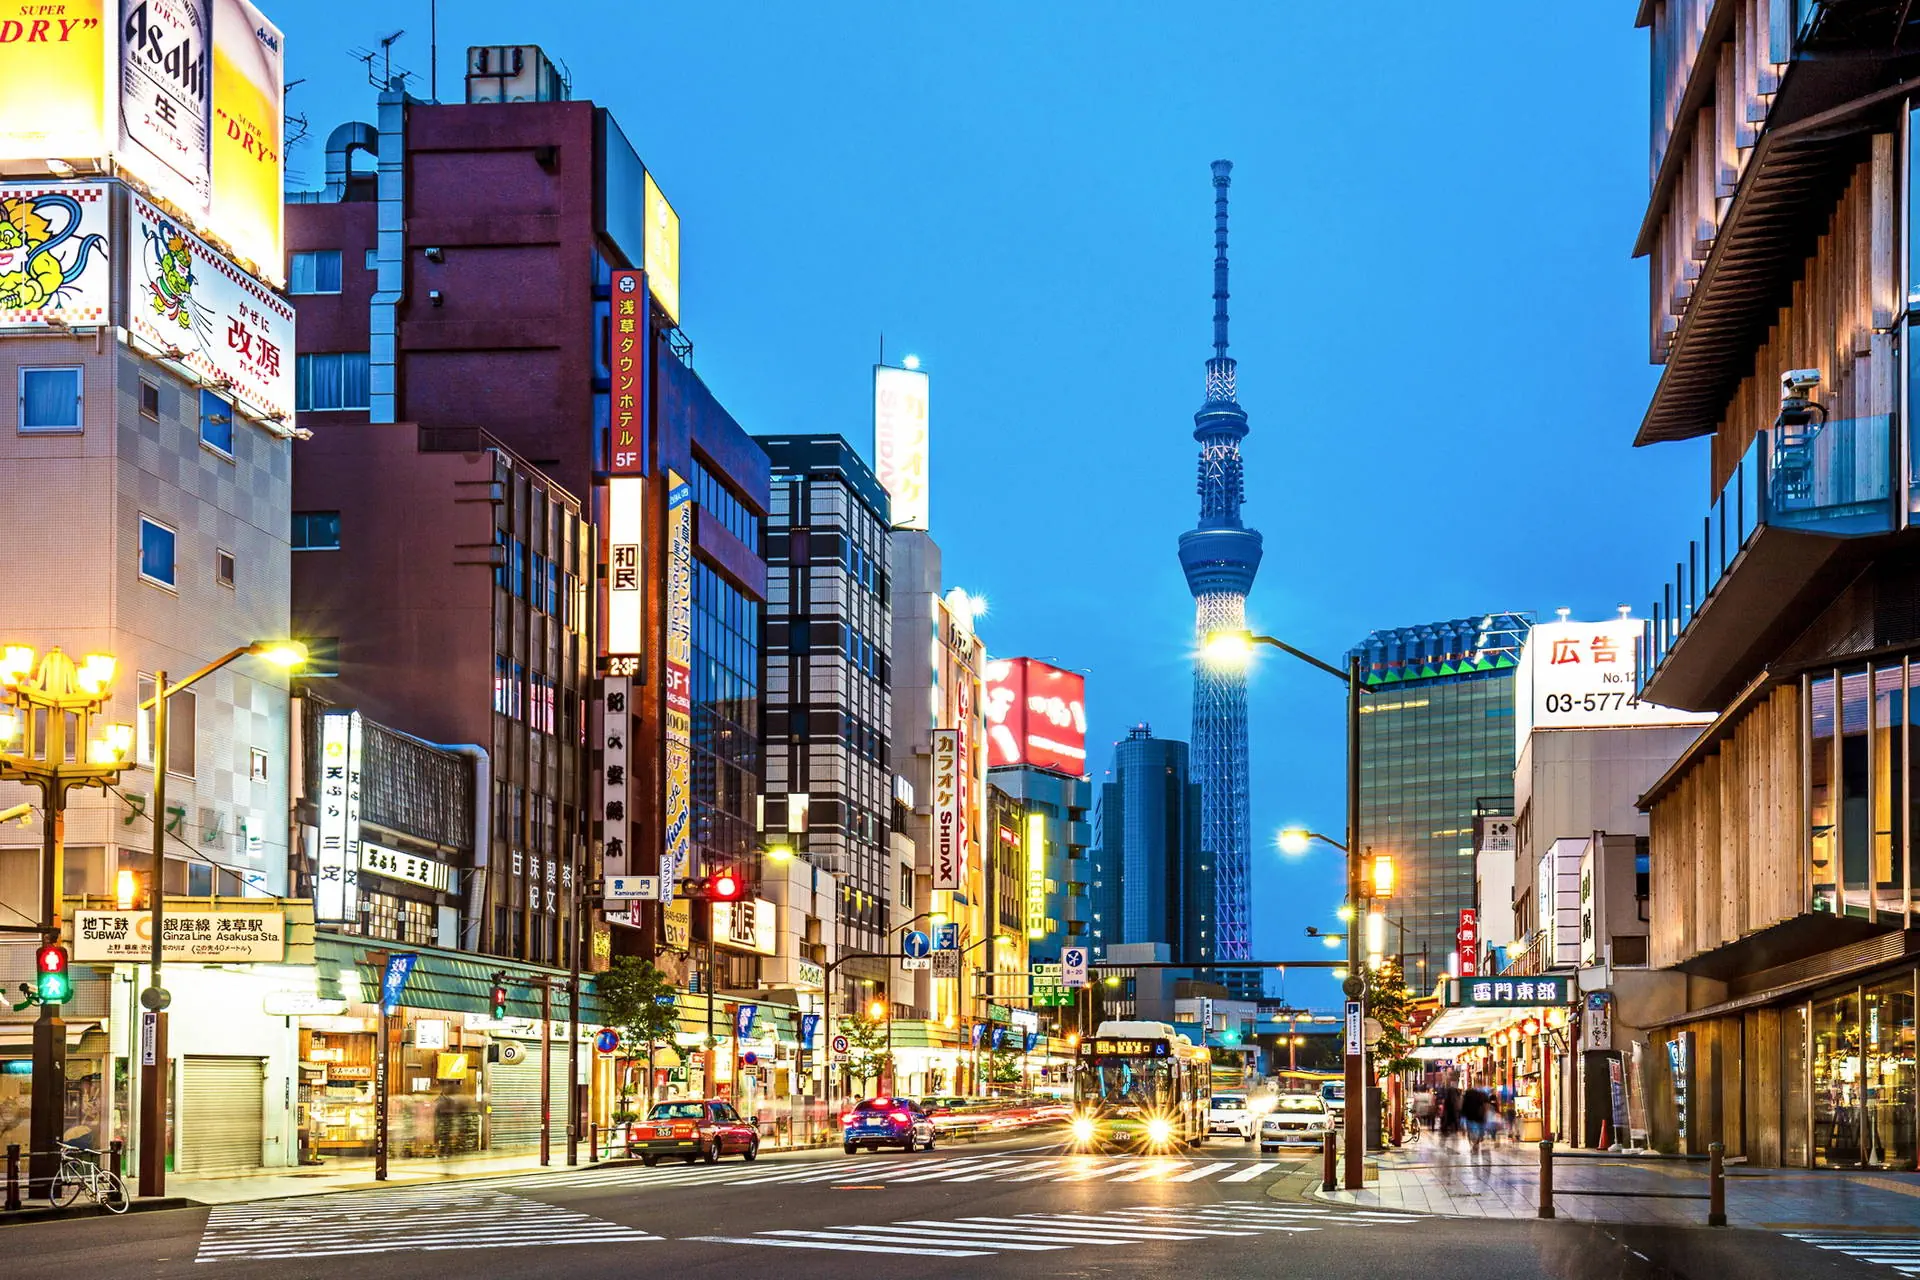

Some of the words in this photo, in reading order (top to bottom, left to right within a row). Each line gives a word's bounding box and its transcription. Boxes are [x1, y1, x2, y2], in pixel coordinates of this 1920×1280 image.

[20, 4, 65, 17] SUPER
[125, 0, 205, 103] Asahi
[256, 26, 278, 53] Asahi
[154, 93, 177, 130] 生
[238, 114, 262, 138] SUPER
[239, 301, 270, 333] かぜに
[227, 315, 281, 378] 改源
[619, 299, 635, 446] 浅草タウンホテル
[616, 452, 637, 467] 5F
[615, 547, 636, 588] 和民
[1550, 636, 1638, 665] 広告
[937, 735, 954, 807] カラオケ
[326, 766, 343, 817] 天ぷら
[321, 835, 342, 882] 三定
[940, 810, 952, 882] SHIDAX
[82, 917, 129, 931] 地下鉄
[163, 918, 211, 931] 銀座線
[216, 918, 263, 932] 浅草駅
[83, 931, 127, 940] SUBWAY
[162, 932, 191, 941] Ginza
[192, 932, 212, 941] Line
[216, 932, 259, 942] Asakusa
[261, 933, 280, 942] Sta.
[666, 924, 678, 943] B1
[1473, 982, 1557, 1001] 雷門東部
